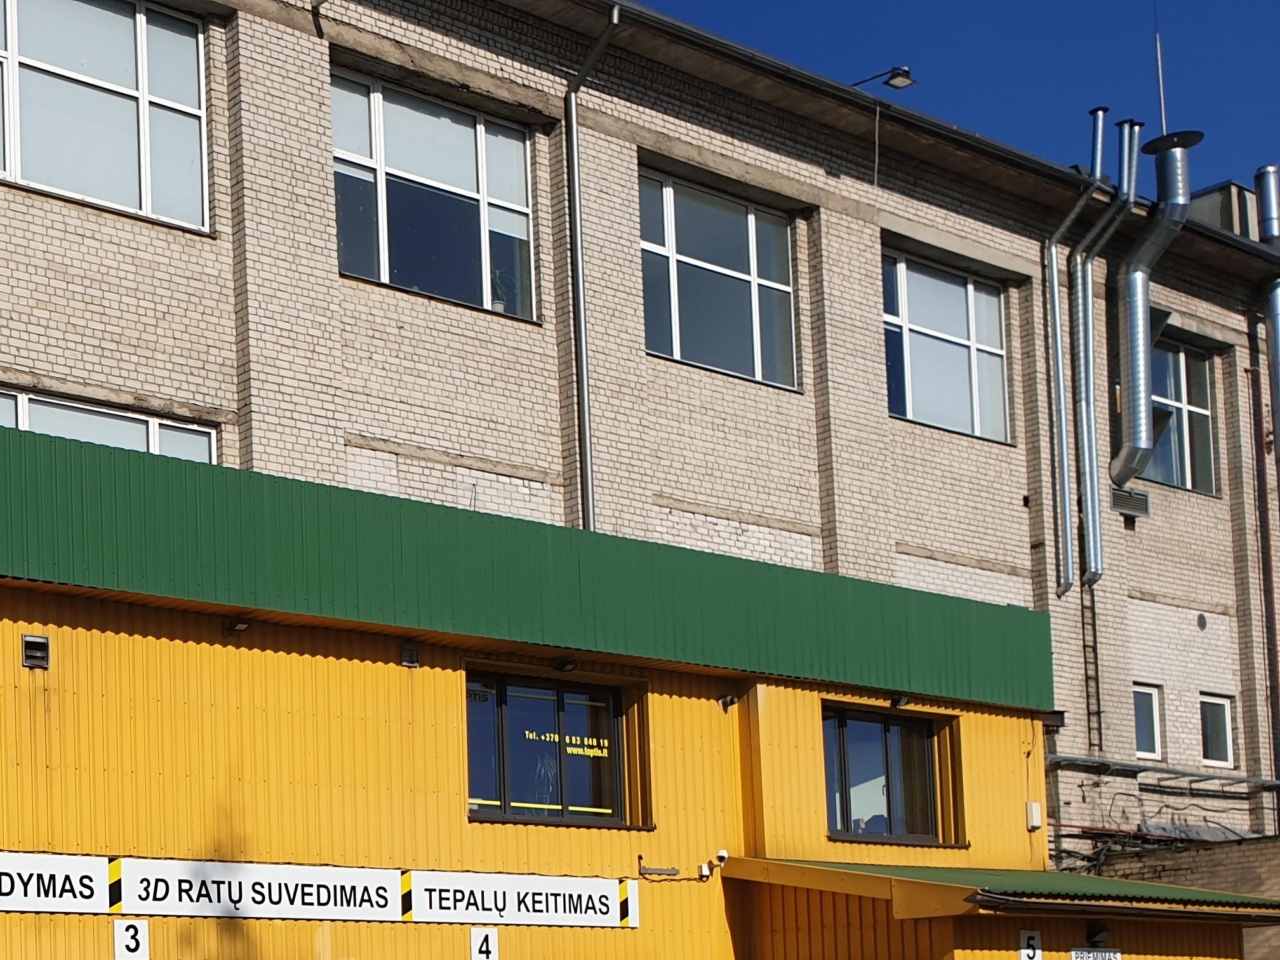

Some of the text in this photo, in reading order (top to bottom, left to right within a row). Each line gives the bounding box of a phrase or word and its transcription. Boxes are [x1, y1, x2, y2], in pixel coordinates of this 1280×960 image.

[524, 731, 539, 740] Tel.
[540, 733, 559, 743] +370
[566, 746, 609, 758] www.toptis.lt
[137, 877, 390, 911] 3D RATŲ SUVEDIMAS
[423, 888, 611, 918] TEPALŲ KEITIMAS
[124, 923, 141, 954] 3
[477, 933, 492, 960] 4
[1026, 935, 1036, 960] 5
